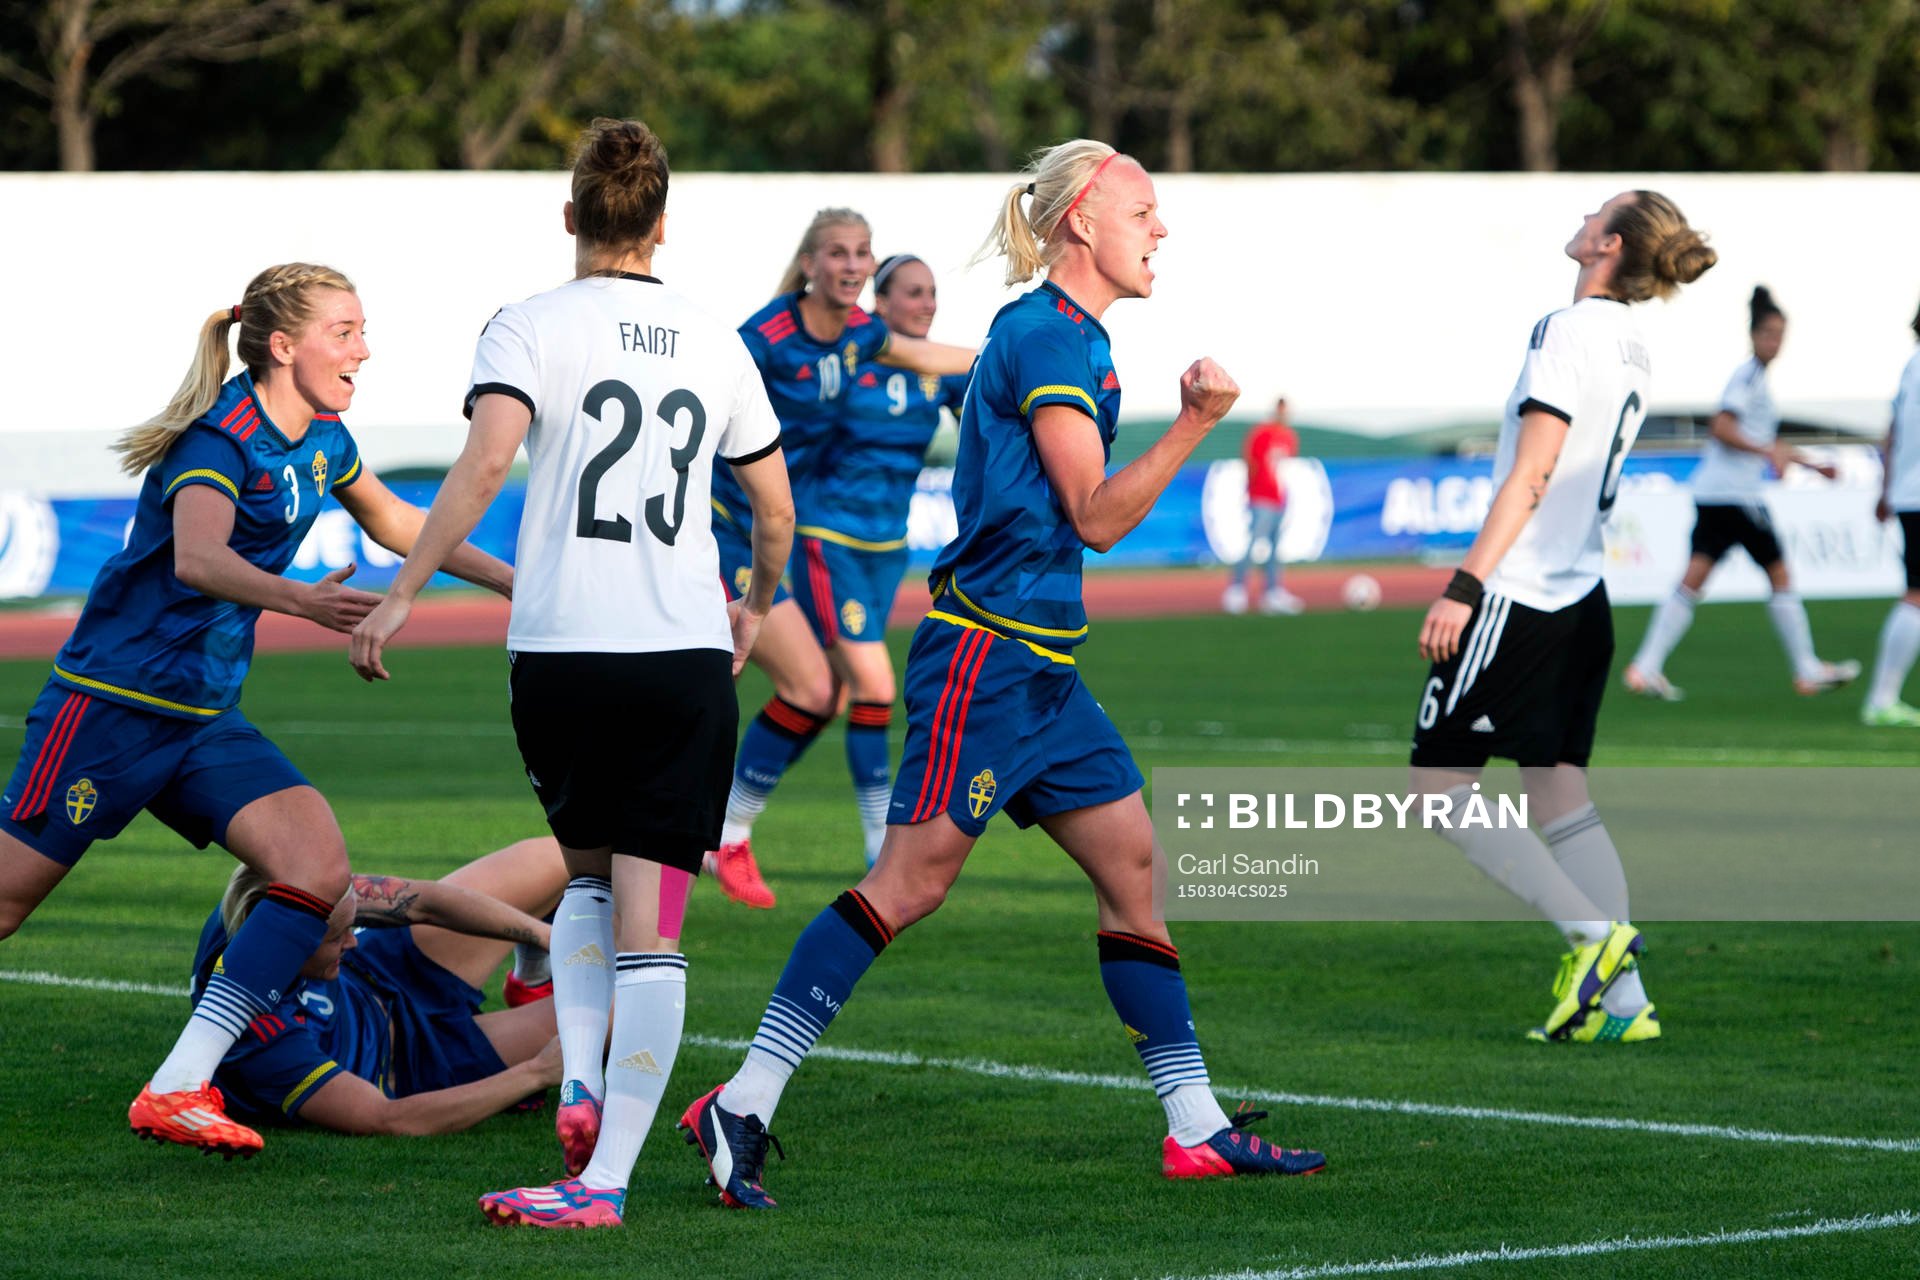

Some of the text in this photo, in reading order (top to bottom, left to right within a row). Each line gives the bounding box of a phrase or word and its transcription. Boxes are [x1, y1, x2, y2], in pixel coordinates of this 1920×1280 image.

[818, 353, 841, 401] 10
[886, 373, 908, 417] 9
[576, 379, 707, 547] 23
[283, 464, 300, 524] 3
[1418, 676, 1444, 730] 6
